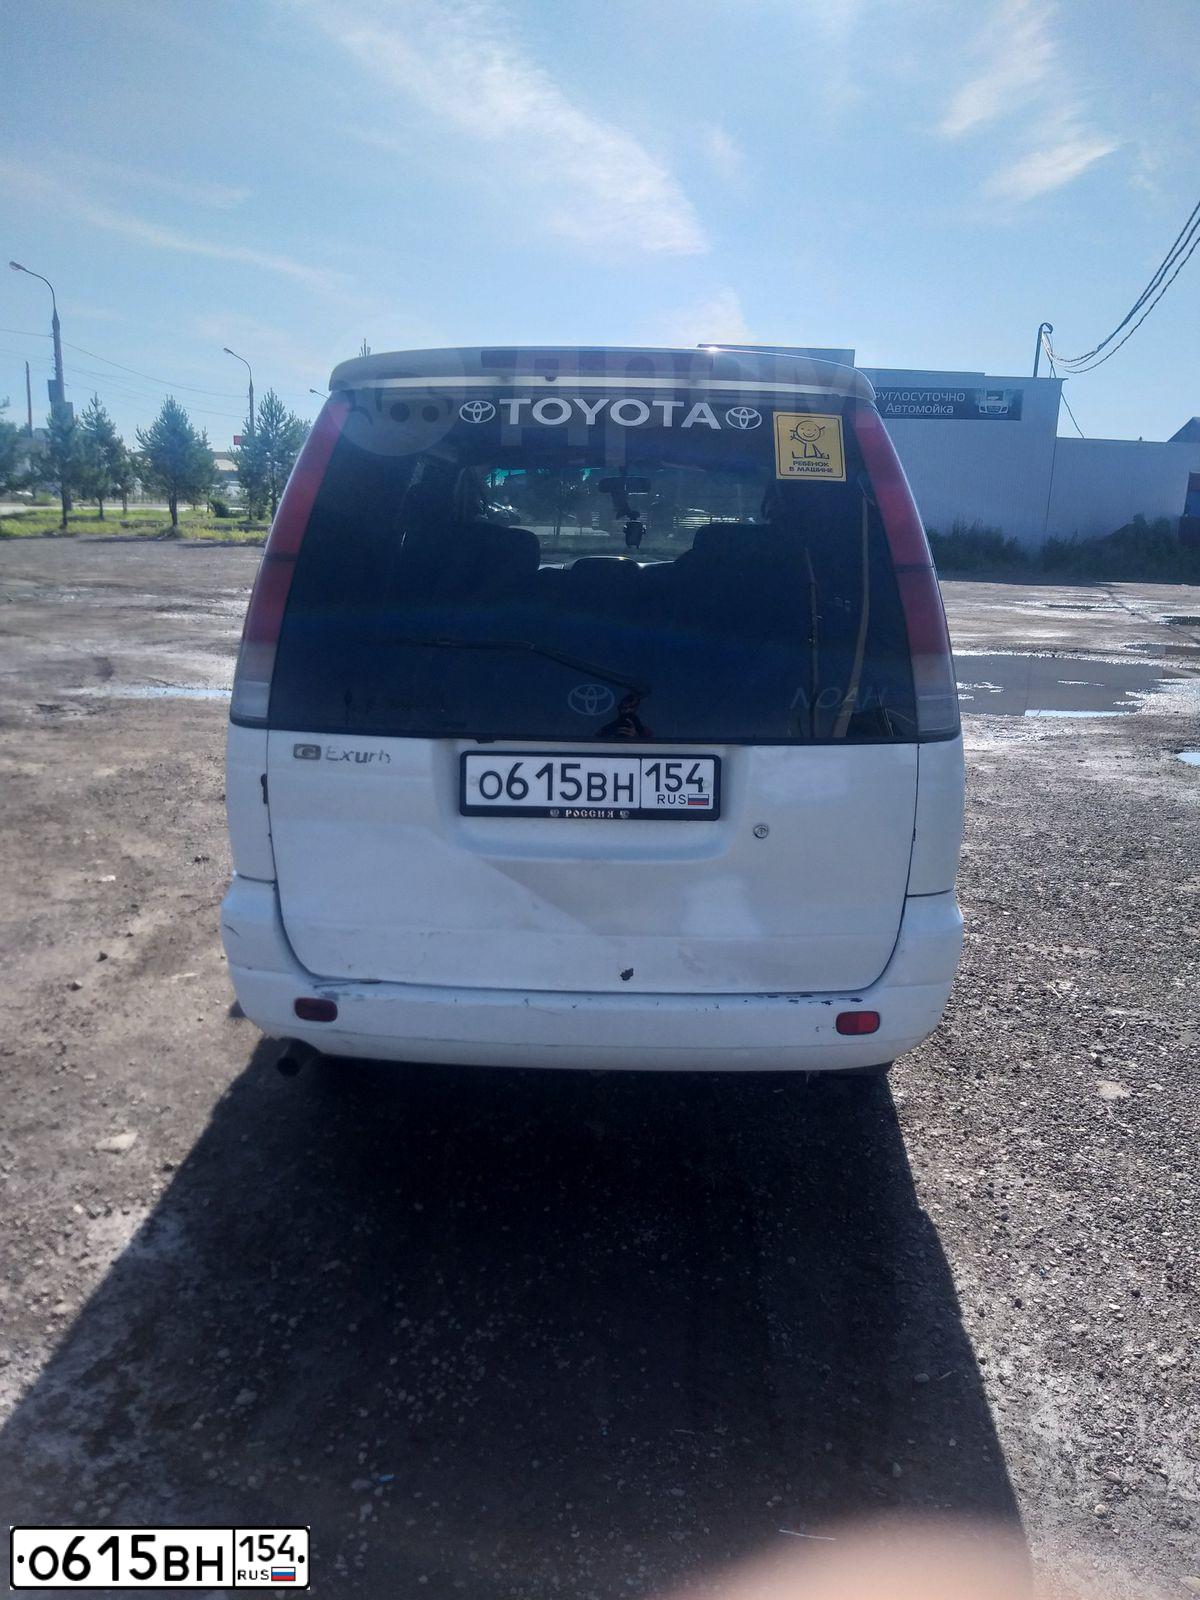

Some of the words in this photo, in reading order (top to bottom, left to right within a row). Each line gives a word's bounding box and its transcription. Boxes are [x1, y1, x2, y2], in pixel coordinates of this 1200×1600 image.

[875, 391, 966, 403] РУГЛОСУТОЧНО
[499, 397, 721, 430] TOYOTA
[885, 402, 954, 415] Автомойка
[789, 687, 888, 709] NOAH
[645, 763, 704, 793] 154
[657, 794, 687, 805] RUS
[565, 809, 614, 819] РОССИЯ
